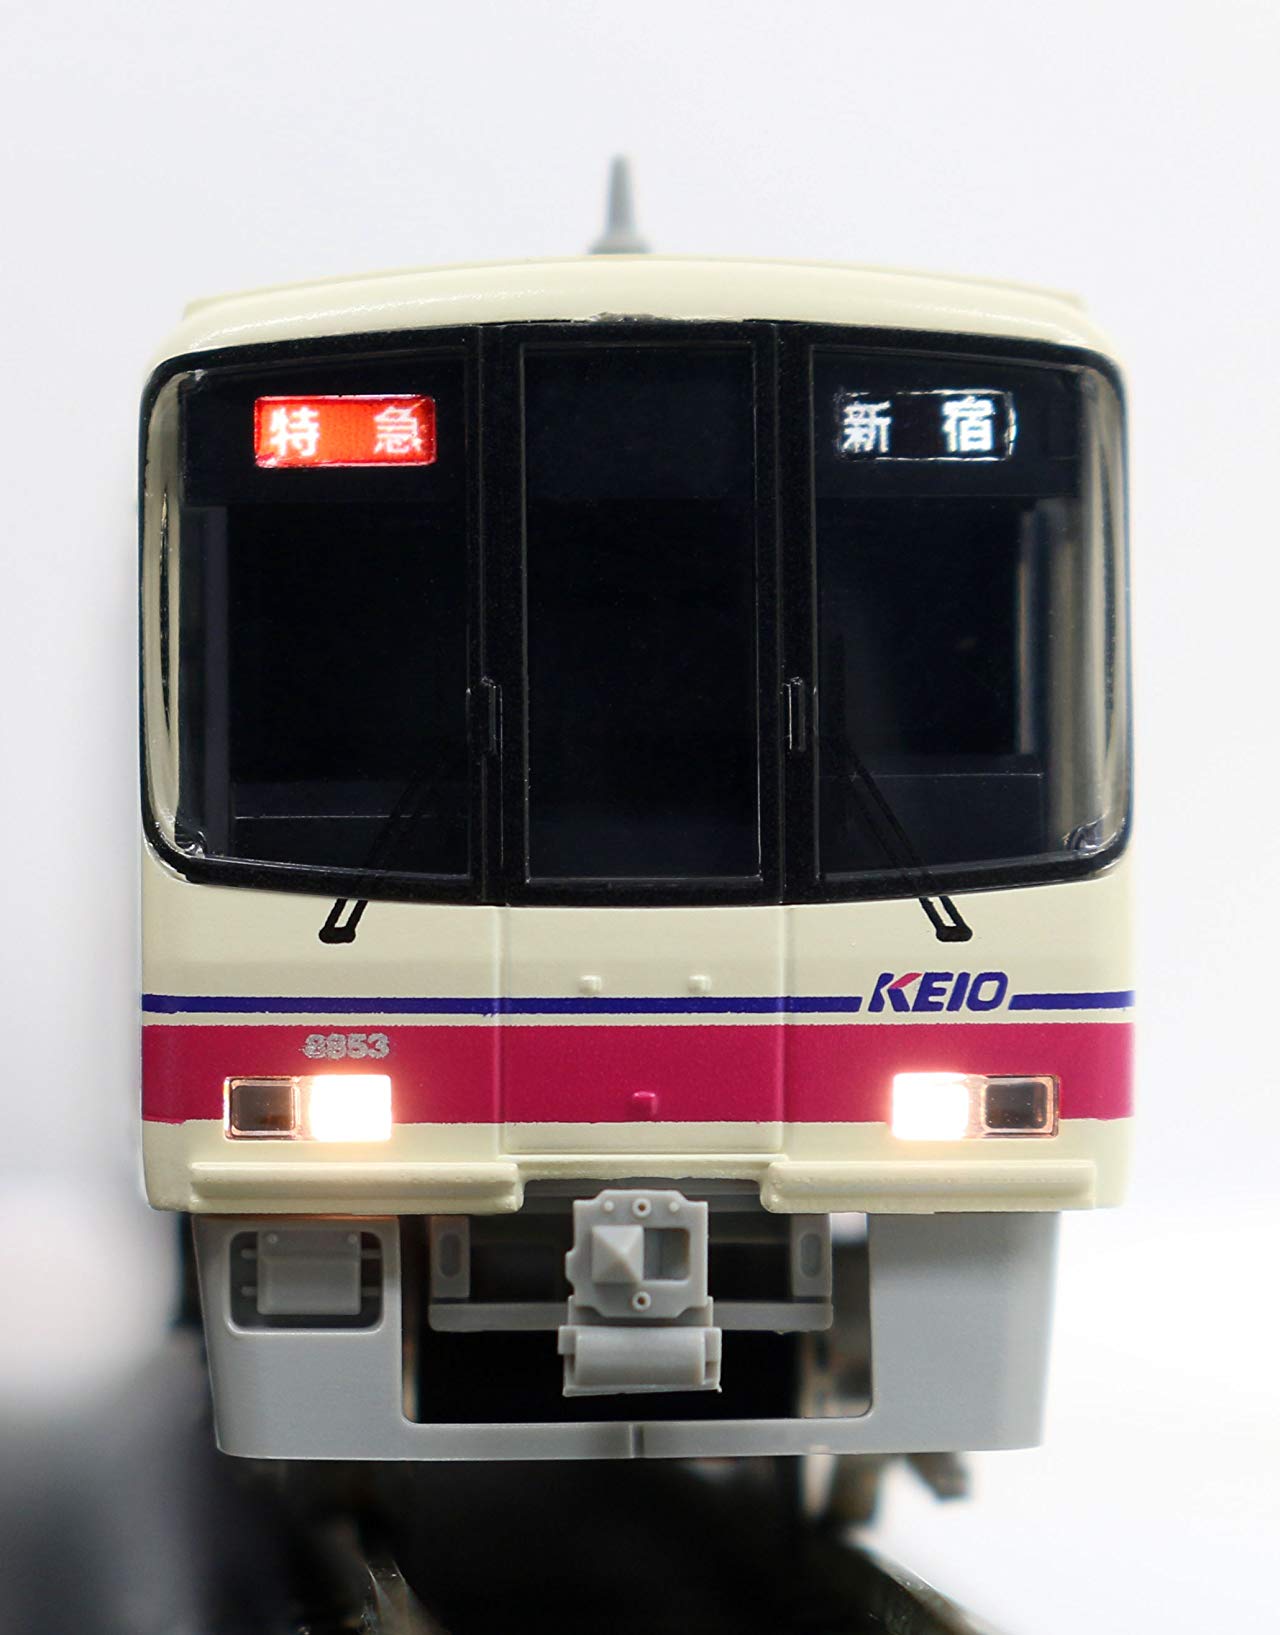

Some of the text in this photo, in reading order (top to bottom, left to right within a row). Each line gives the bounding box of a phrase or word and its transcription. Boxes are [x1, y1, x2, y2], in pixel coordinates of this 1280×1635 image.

[269, 405, 421, 457] 特急
[842, 395, 996, 453] 新宿
[867, 971, 1009, 1013] KEIO
